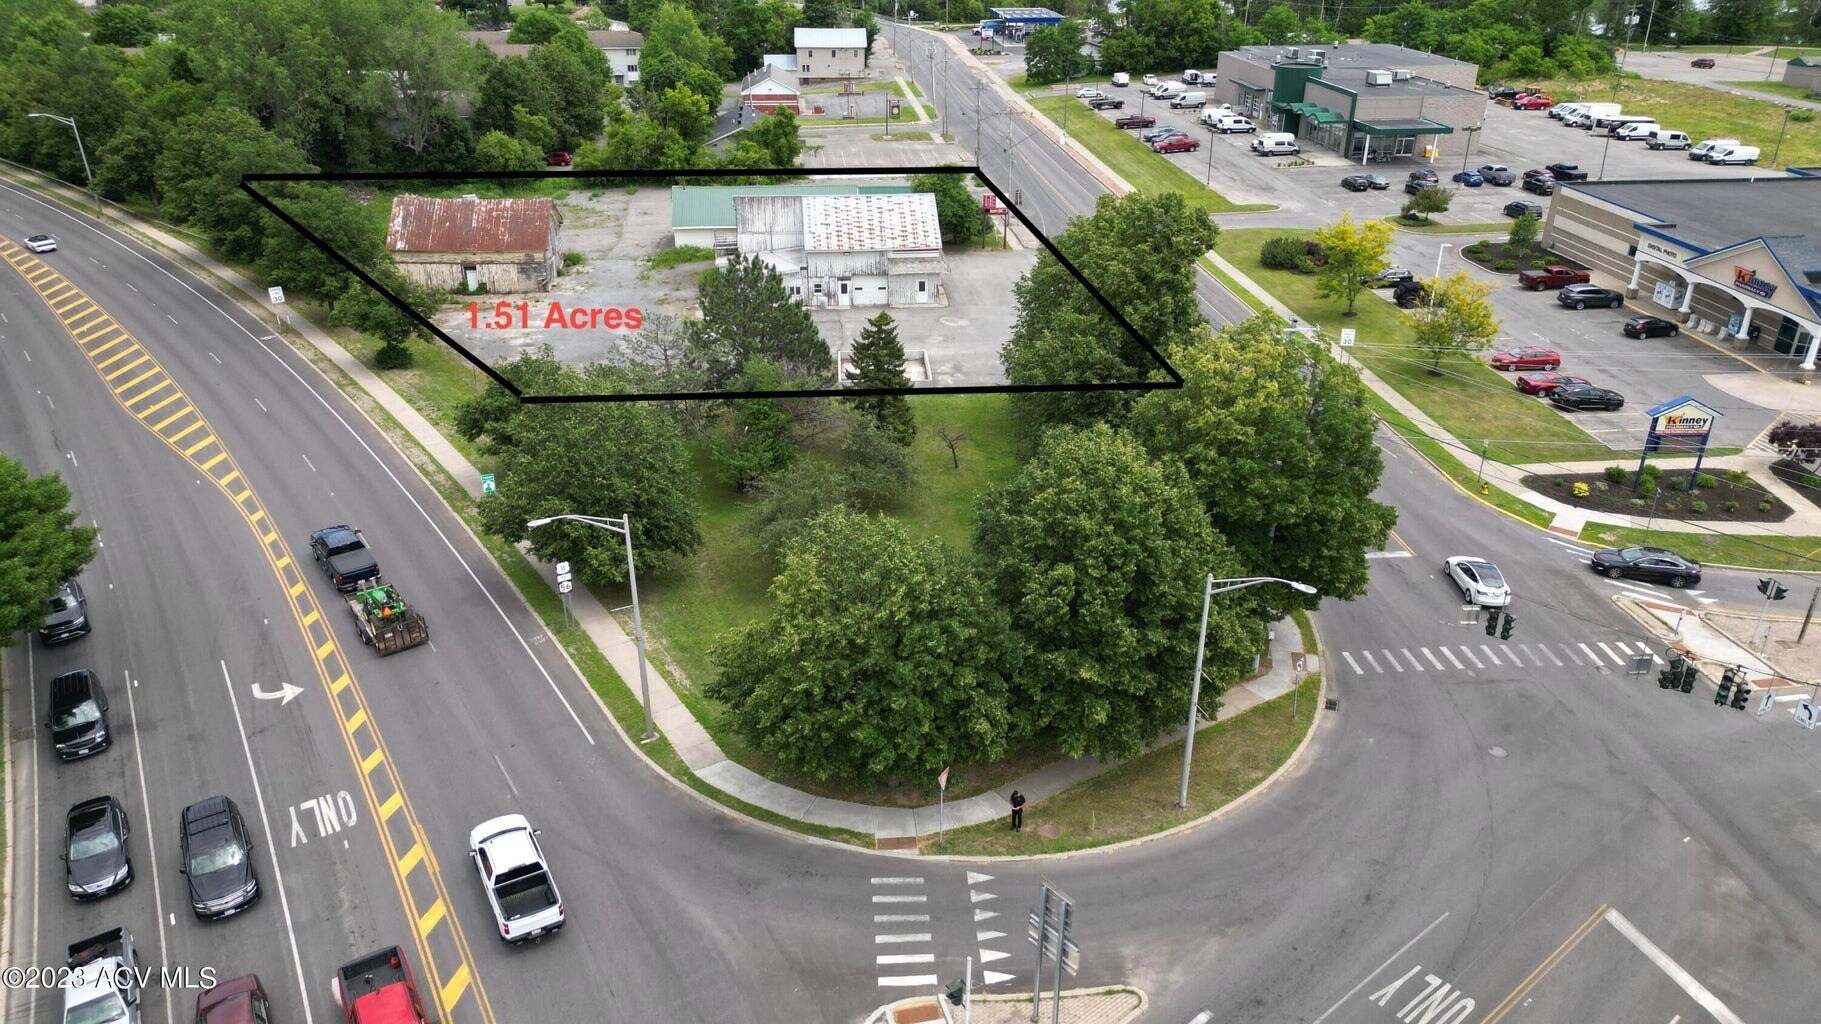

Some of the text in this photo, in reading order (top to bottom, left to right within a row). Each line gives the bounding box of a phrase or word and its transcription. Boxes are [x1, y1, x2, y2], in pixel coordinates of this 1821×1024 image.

[1662, 248, 1678, 258] PHOTO
[1666, 414, 1708, 428] Kinney
[560, 584, 570, 592] 56
[1796, 716, 1812, 726] ONLY
[289, 790, 357, 848] ONLY
[1368, 965, 1476, 1024] ONLY
